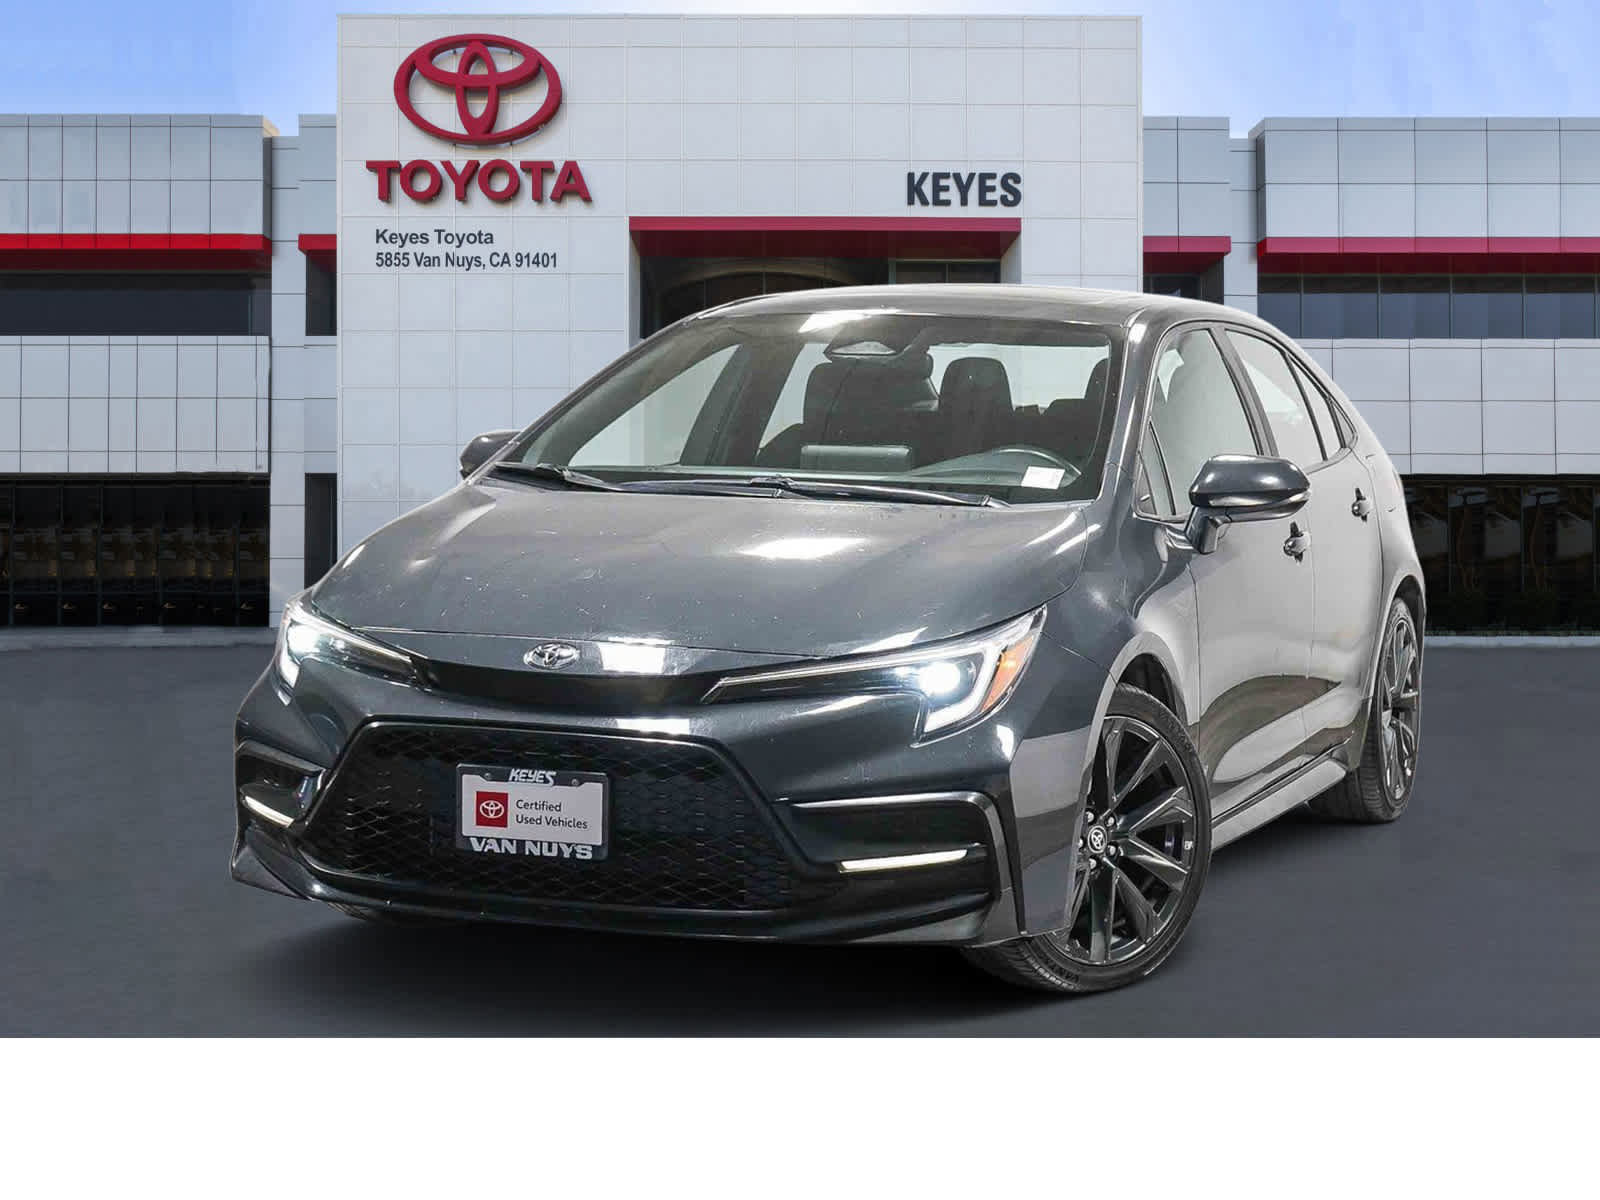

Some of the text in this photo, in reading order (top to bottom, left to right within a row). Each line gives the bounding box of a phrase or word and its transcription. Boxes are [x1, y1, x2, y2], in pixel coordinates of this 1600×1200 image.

[366, 159, 592, 202] TOYOTA
[907, 172, 1022, 207] KEYES
[375, 229, 494, 248] Keyes Toyota
[375, 252, 557, 271] 5855 Van Nuys, CA 91401
[508, 768, 556, 786] KEYES
[515, 799, 562, 812] Certified
[515, 815, 588, 829] Used Vehicles
[469, 837, 593, 860] VAN NUYS
